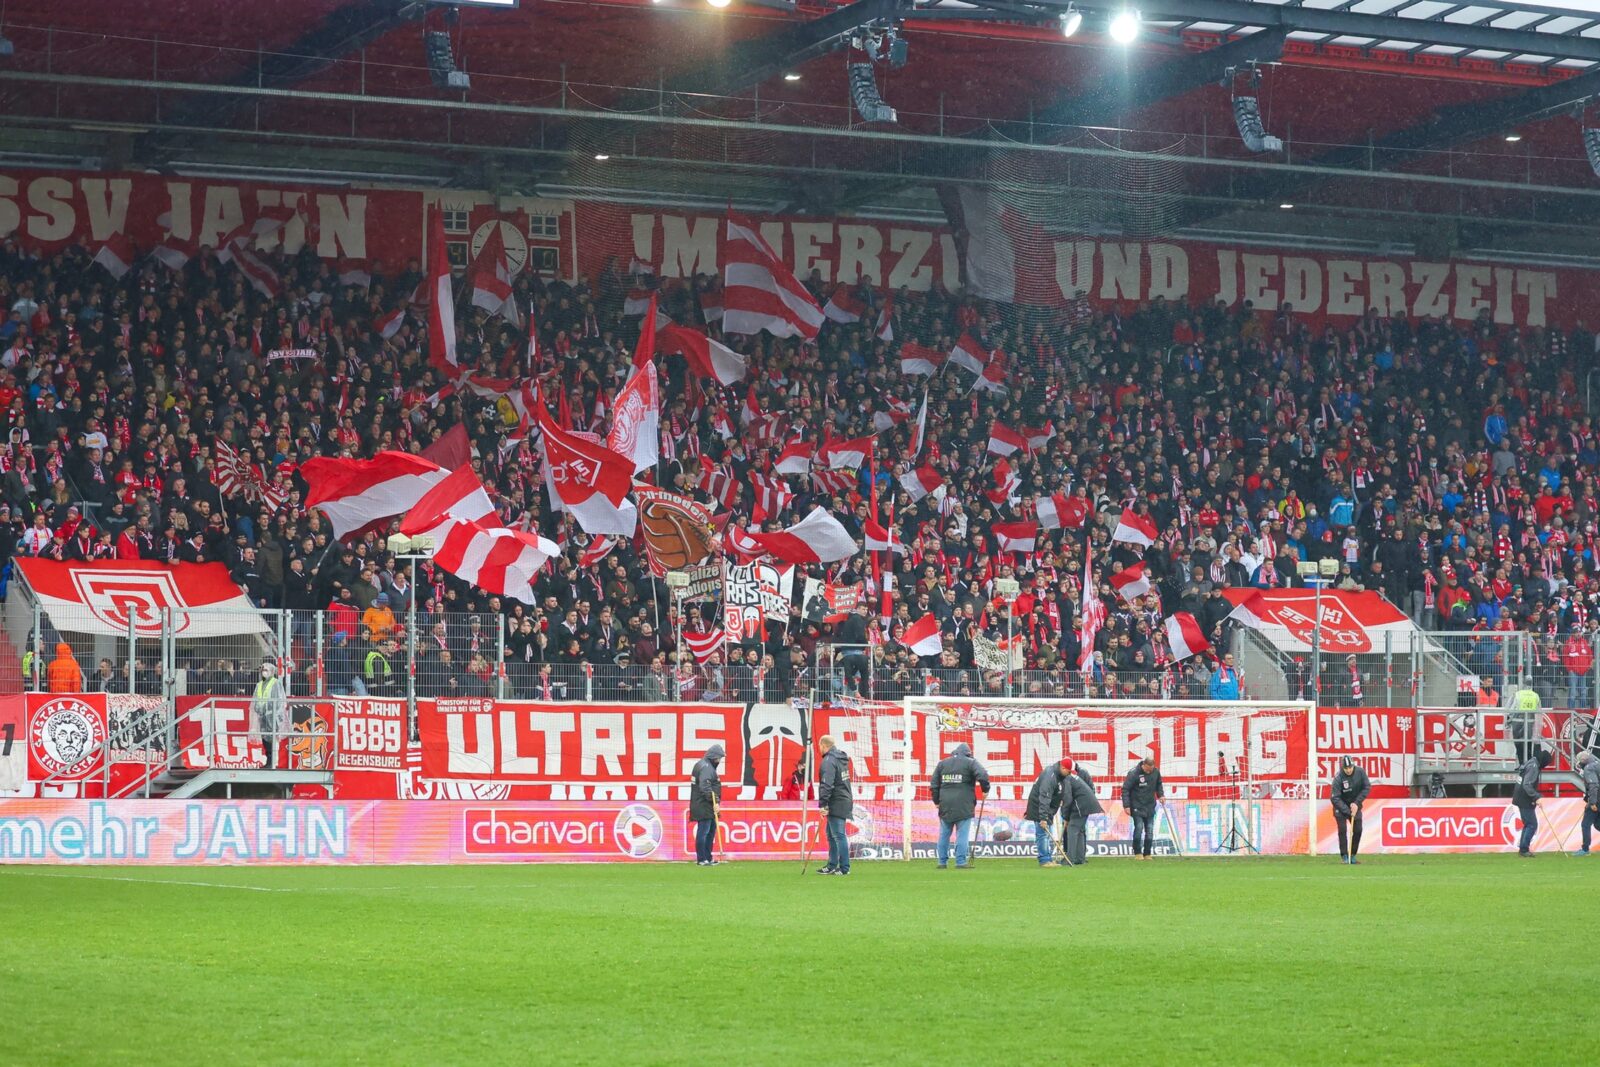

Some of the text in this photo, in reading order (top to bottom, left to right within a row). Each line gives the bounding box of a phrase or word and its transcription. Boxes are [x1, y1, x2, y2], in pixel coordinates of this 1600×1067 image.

[1054, 242, 1189, 300] UND
[1214, 250, 1557, 326] JEDERZEIT
[338, 701, 400, 717] SSV JAHN
[338, 717, 400, 753] 1889
[446, 712, 725, 776] ULTRAS
[1318, 714, 1390, 749] JAHN
[339, 753, 400, 768] REGENSBURG
[0, 804, 346, 855] mehr JAHN
[472, 810, 604, 844] charivari
[1387, 808, 1494, 838] charivari
